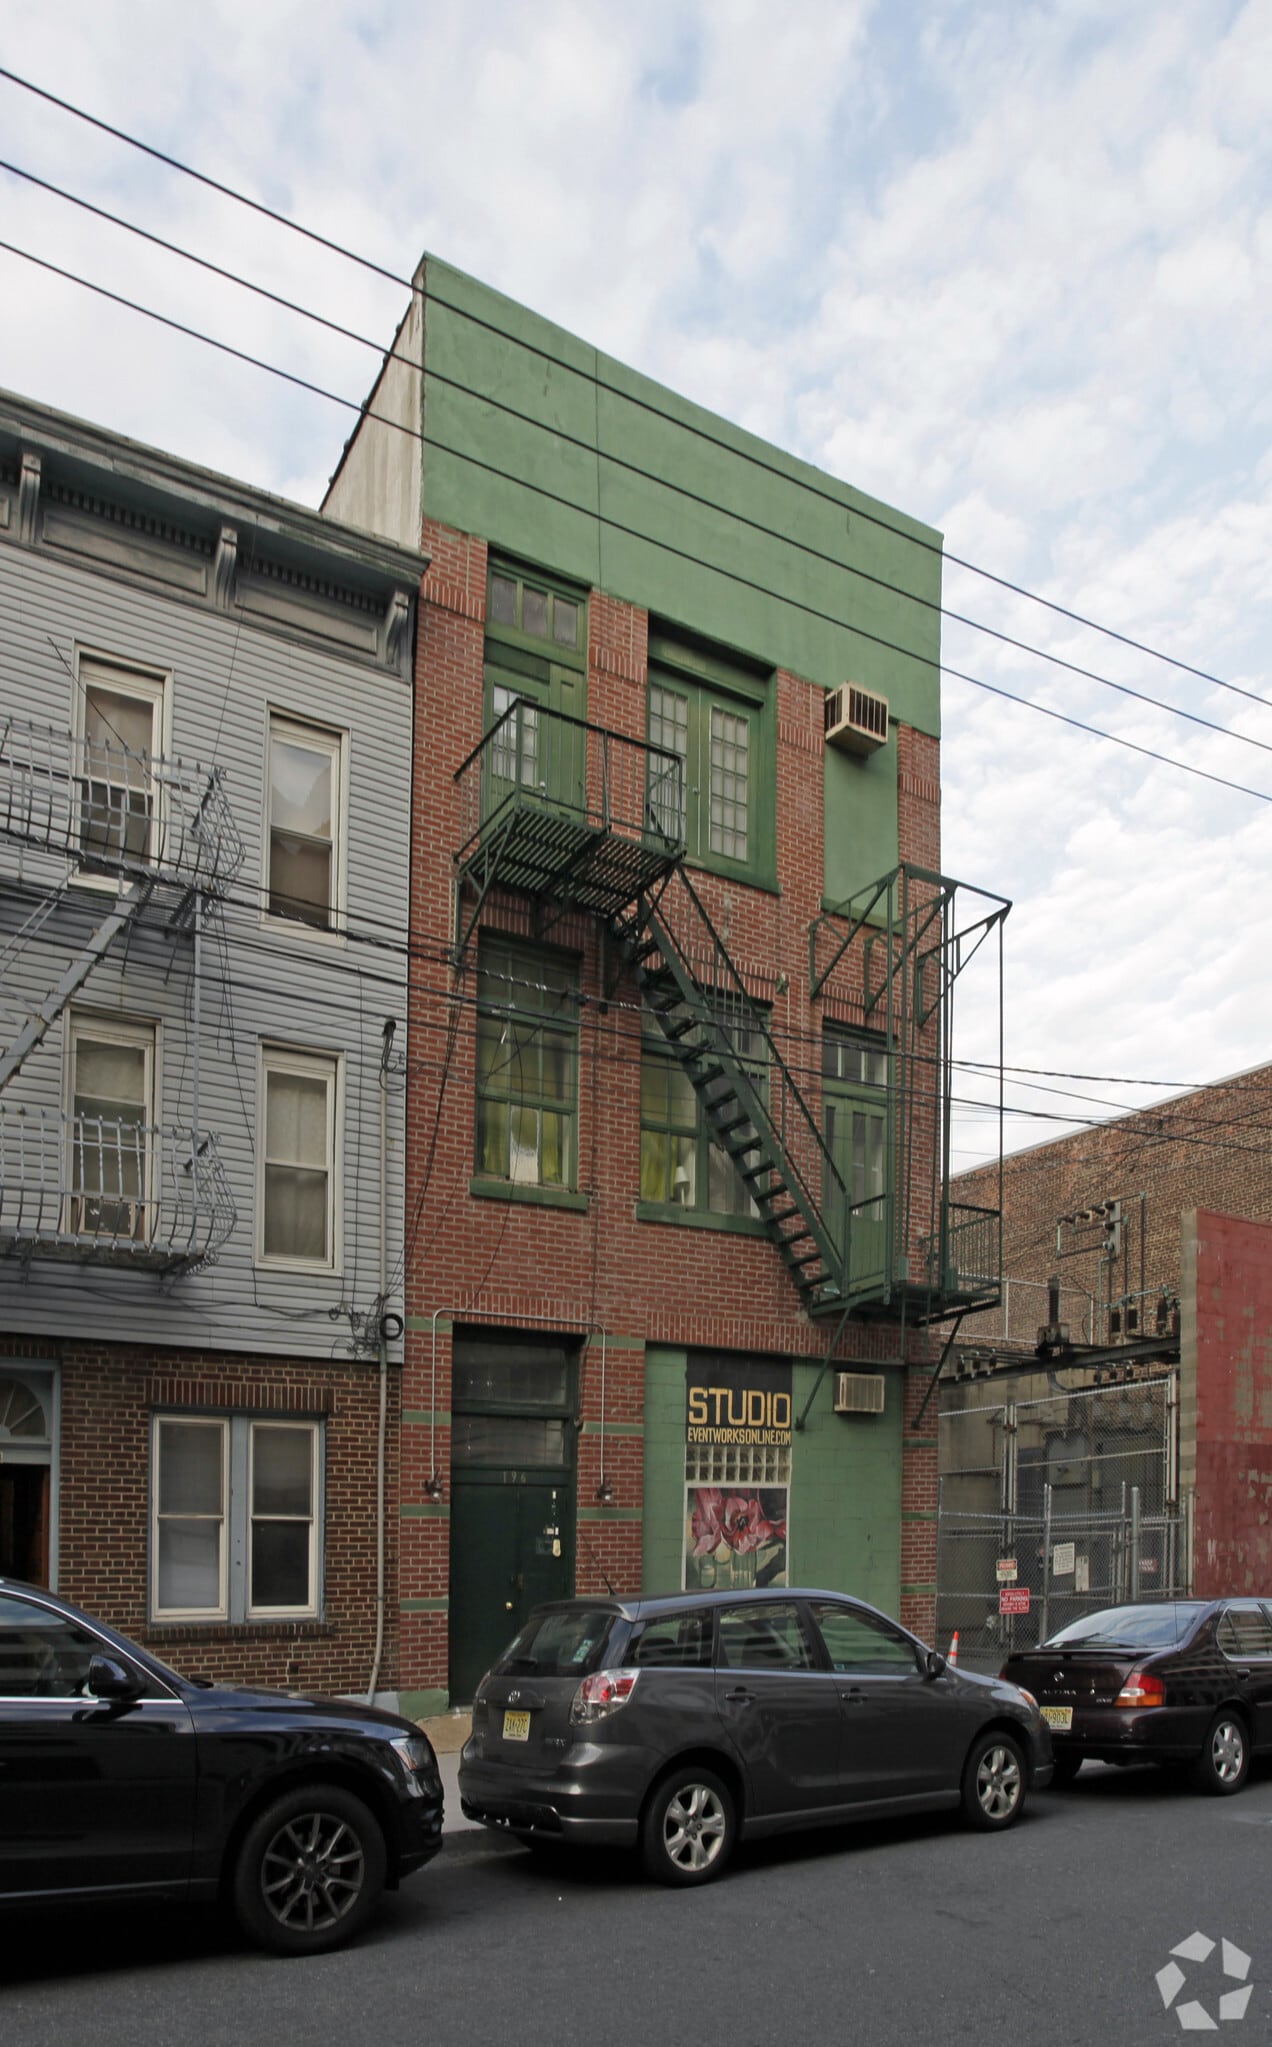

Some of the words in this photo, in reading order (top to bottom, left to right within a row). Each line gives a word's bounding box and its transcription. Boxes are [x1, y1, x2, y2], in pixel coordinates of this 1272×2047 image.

[688, 1387, 791, 1429] STUDIO
[687, 1427, 792, 1446] EVENTWORKSONLINE.COM
[503, 1471, 527, 1484] 196
